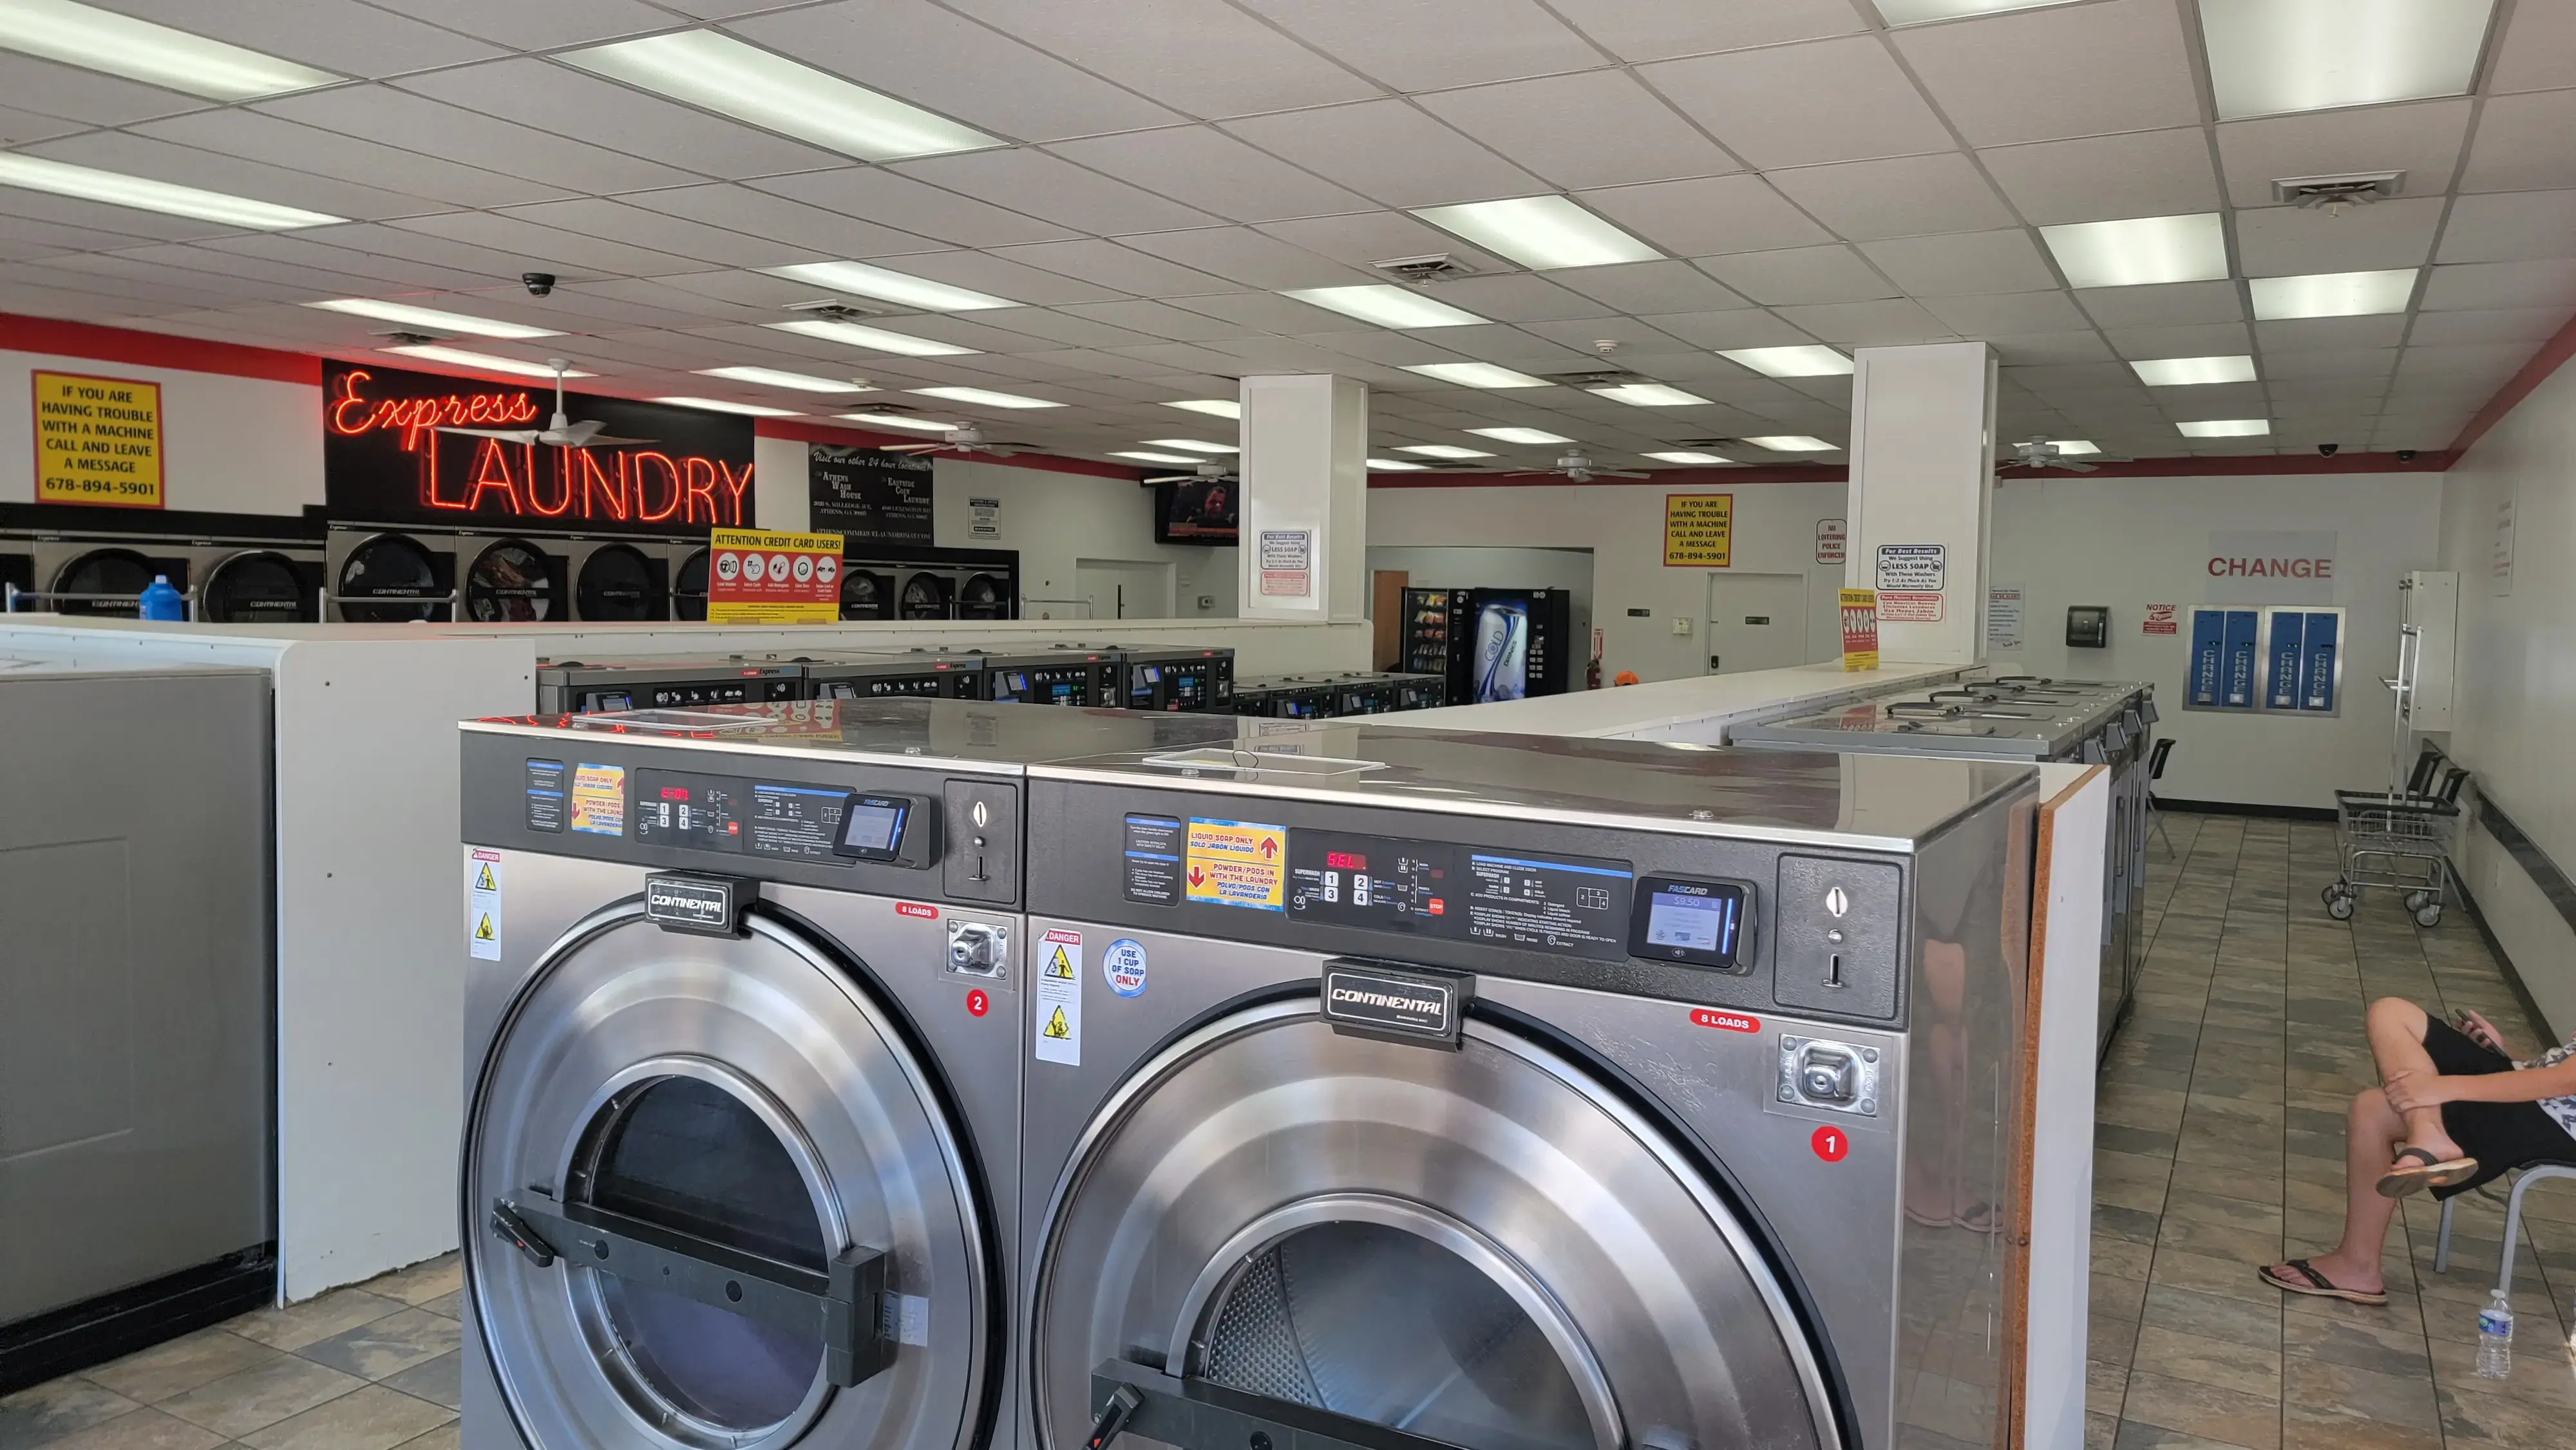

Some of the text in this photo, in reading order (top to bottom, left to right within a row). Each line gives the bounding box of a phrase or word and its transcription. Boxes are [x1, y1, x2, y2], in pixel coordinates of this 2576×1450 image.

[62, 385, 132, 403] IF YOU ARE
[42, 402, 153, 422] HAVING TROUBLE
[336, 372, 538, 451] Express
[43, 420, 154, 440] WITH A MACHINE
[46, 438, 151, 457] CALL AND LEAVE
[64, 458, 135, 473] A MESSAGE
[813, 451, 831, 463] Visit
[848, 457, 866, 466] other
[868, 458, 878, 467] 24
[881, 459, 895, 469] hour
[430, 428, 753, 525] LAUNDRY
[46, 478, 154, 495] 678-894-5901
[715, 534, 840, 549] ATTENTION CREDIT CARD USERS!
[2208, 557, 2332, 578] CHANGE
[1485, 630, 1504, 661] COLD
[1504, 641, 1517, 667] DRINKS
[2202, 650, 2215, 692] CHANGE
[2233, 650, 2247, 693] CHANGE
[2279, 652, 2293, 695] CHANGE
[2313, 653, 2327, 697] CHANGE
[1214, 863, 1265, 875] POWDER/PODS
[1328, 853, 1353, 868] SEL
[1217, 881, 1255, 890] POLVO/PODS
[1245, 876, 1278, 885] LAUNDRY
[1229, 890, 1267, 899] LAVANDERIA
[1668, 885, 1708, 895] FASCARD
[651, 895, 721, 912] CONTINENTAL
[908, 907, 931, 917] LOADS
[1049, 932, 1079, 943] DANGER
[1121, 949, 1137, 958] USE
[1124, 958, 1139, 966] CUP
[1124, 967, 1144, 976] SOAP
[1116, 975, 1140, 986] ONLY
[973, 995, 982, 1010] 2
[1332, 988, 1442, 1015] CONTINENTAL
[1701, 1013, 1750, 1030] 8 LOADS
[1825, 1135, 1836, 1154] 1
